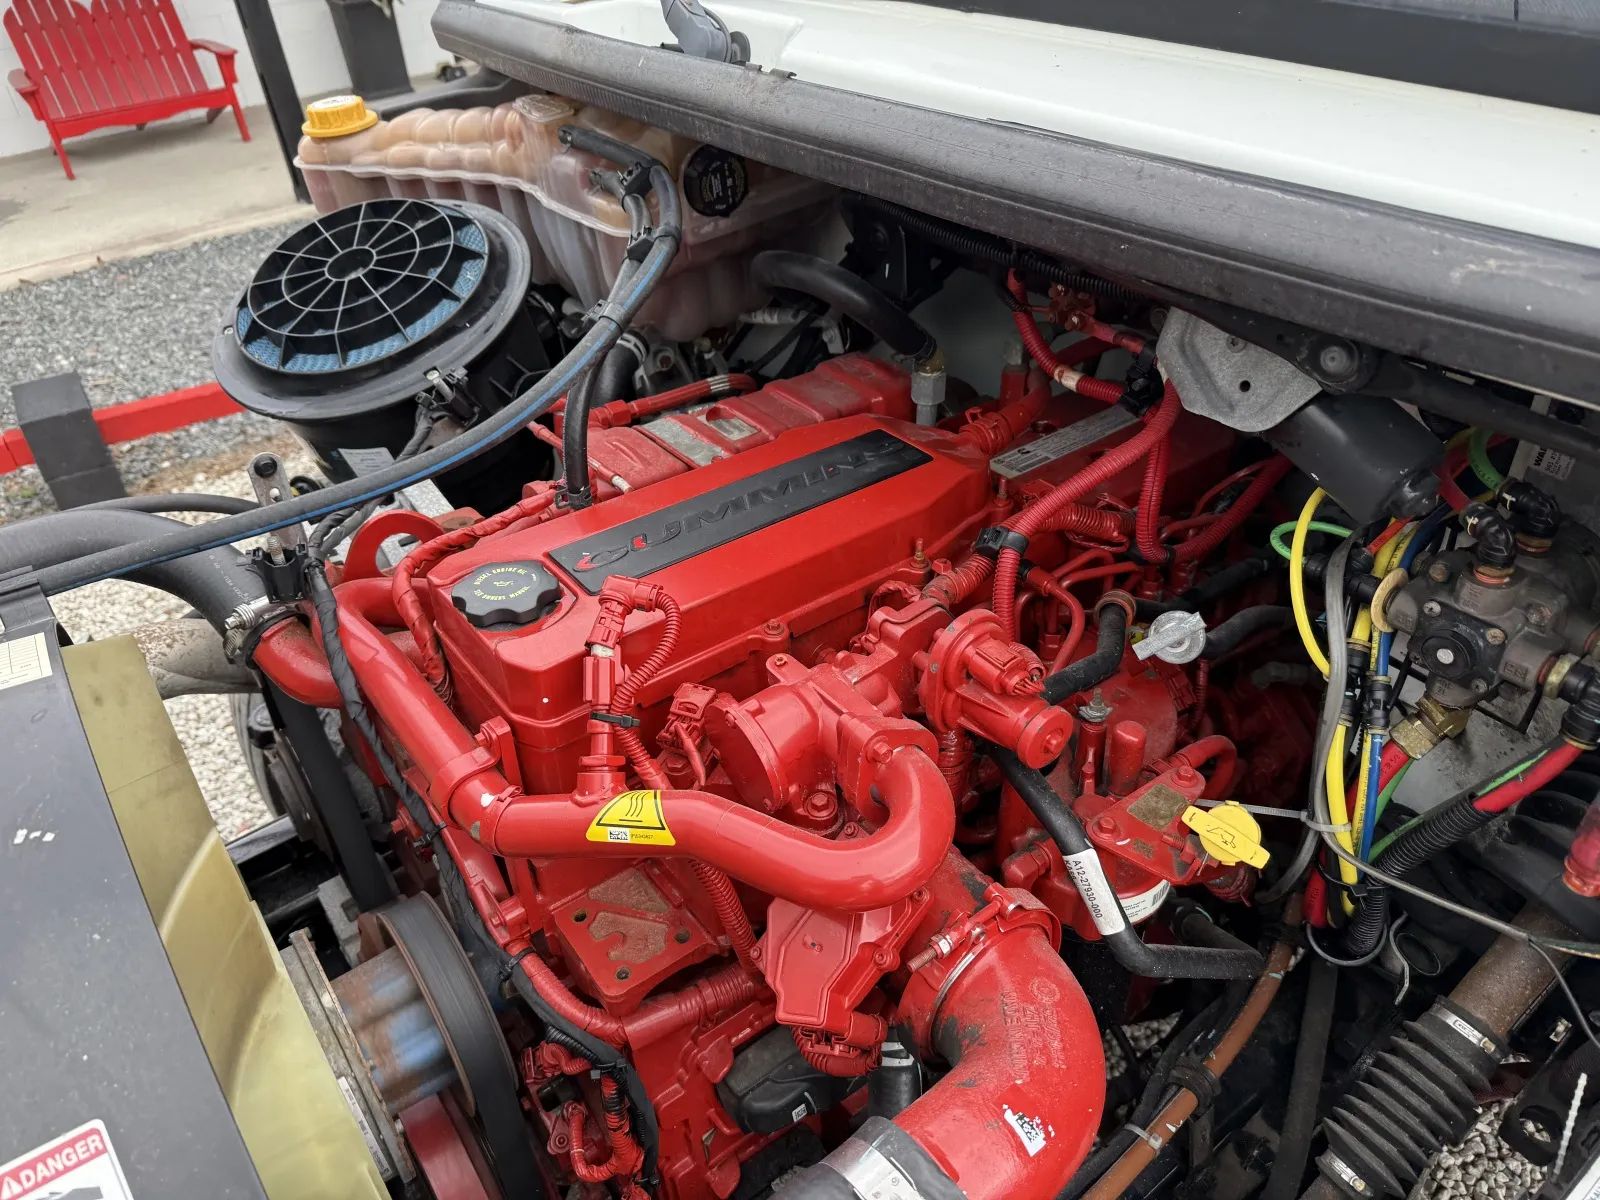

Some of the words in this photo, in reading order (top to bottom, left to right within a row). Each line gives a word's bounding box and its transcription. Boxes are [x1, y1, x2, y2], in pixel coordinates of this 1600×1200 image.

[572, 440, 906, 573] CUMMINS
[1072, 859, 1103, 919] A12-27930-000
[18, 1133, 104, 1190] DANGER
